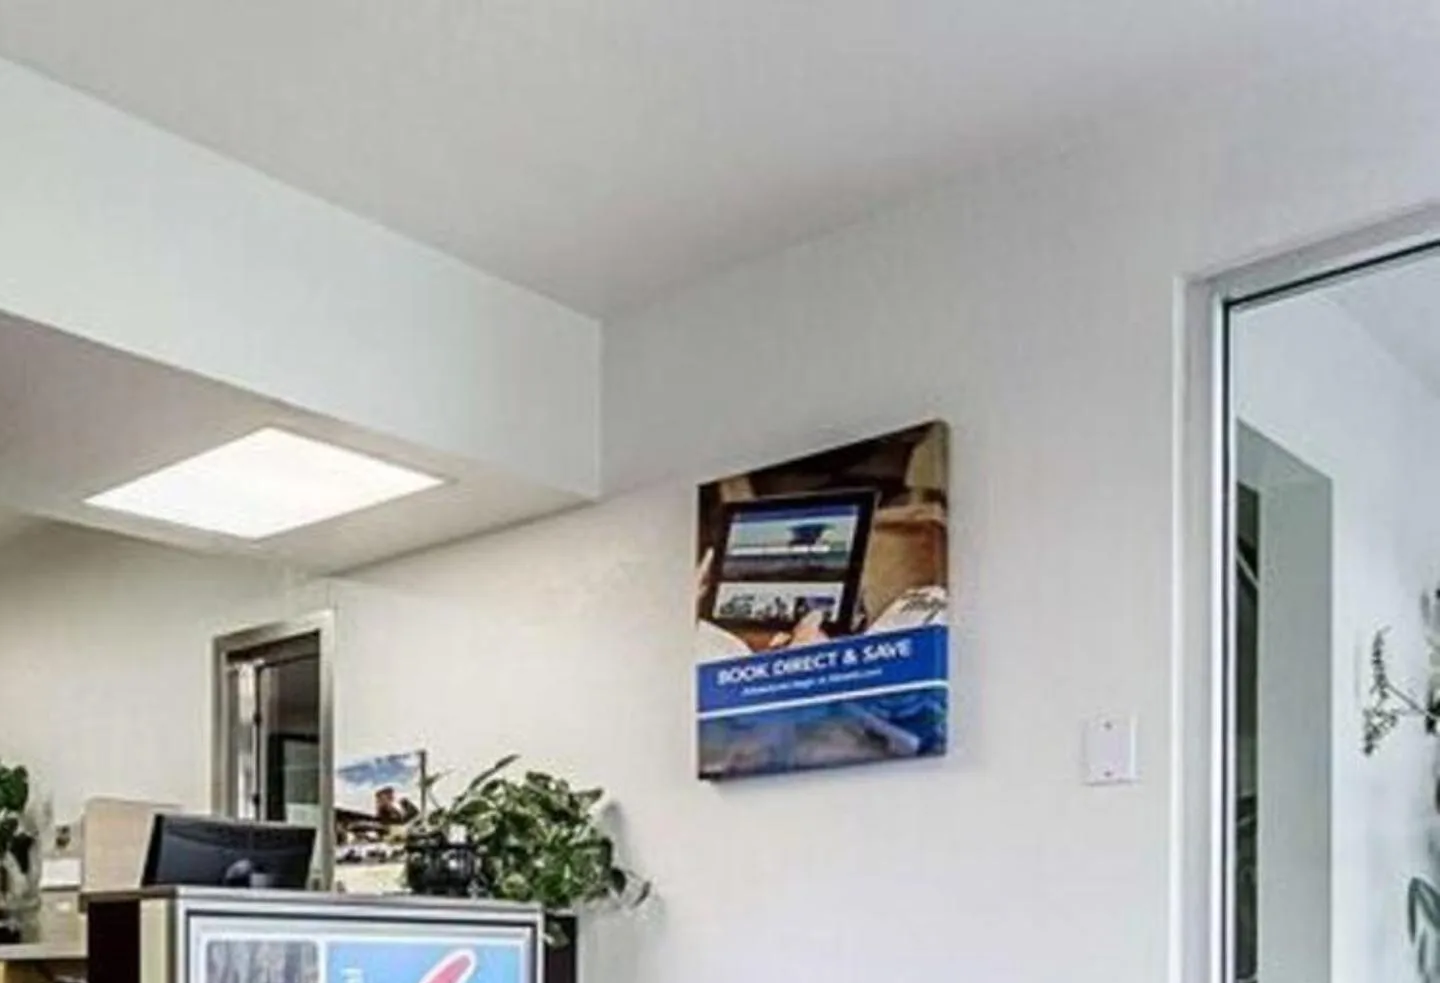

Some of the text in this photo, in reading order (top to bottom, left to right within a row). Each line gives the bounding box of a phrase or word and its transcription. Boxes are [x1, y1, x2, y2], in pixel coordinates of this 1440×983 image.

[717, 662, 771, 686] BOOK
[773, 651, 837, 676] DIRECT
[842, 648, 858, 665] &
[862, 638, 911, 663] SAVE
